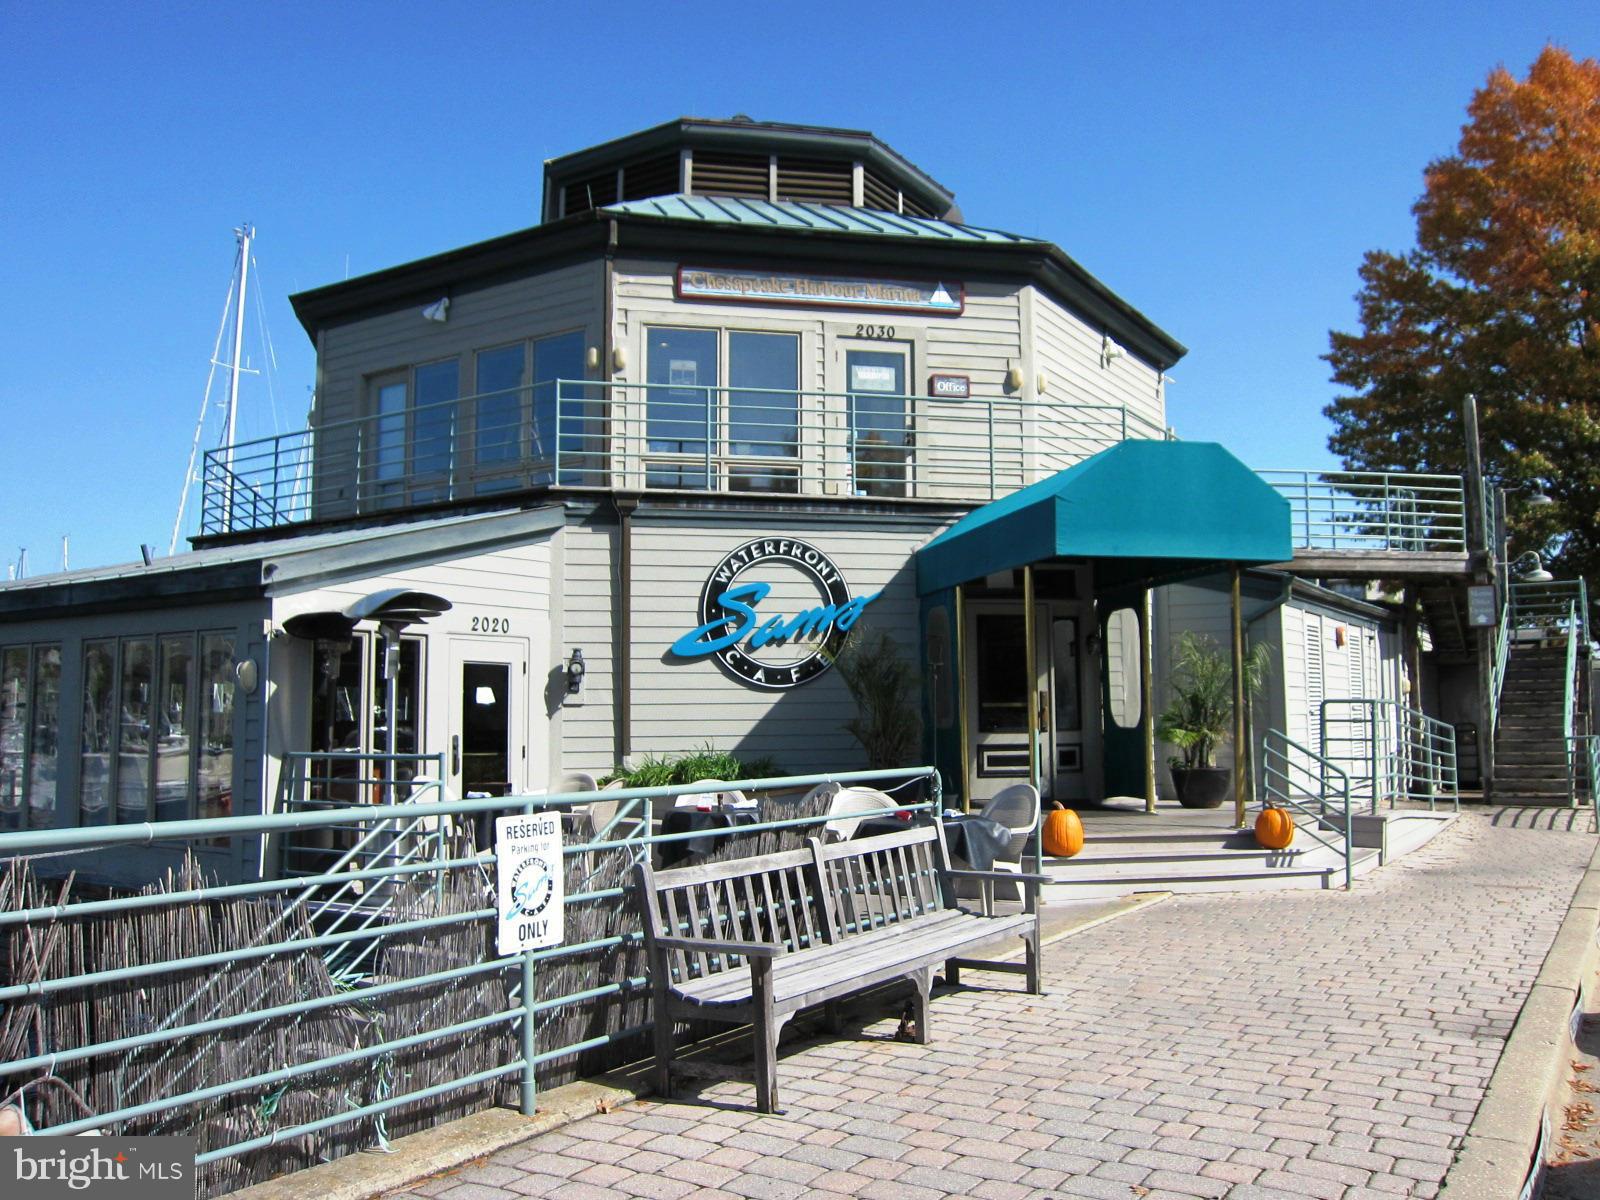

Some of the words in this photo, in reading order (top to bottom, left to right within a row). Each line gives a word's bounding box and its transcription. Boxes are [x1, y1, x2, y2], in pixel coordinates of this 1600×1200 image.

[689, 271, 790, 295] Chesapeake
[794, 279, 859, 298] Harbour
[865, 283, 920, 302] Marina
[855, 323, 896, 339] 2030
[936, 380, 967, 393] Office
[714, 540, 841, 584] WATERFRONT
[471, 616, 510, 634] 2020
[671, 582, 885, 657] Sams
[506, 820, 555, 840] RESERVED
[511, 844, 539, 856] Parking
[518, 919, 548, 942] ONLY
